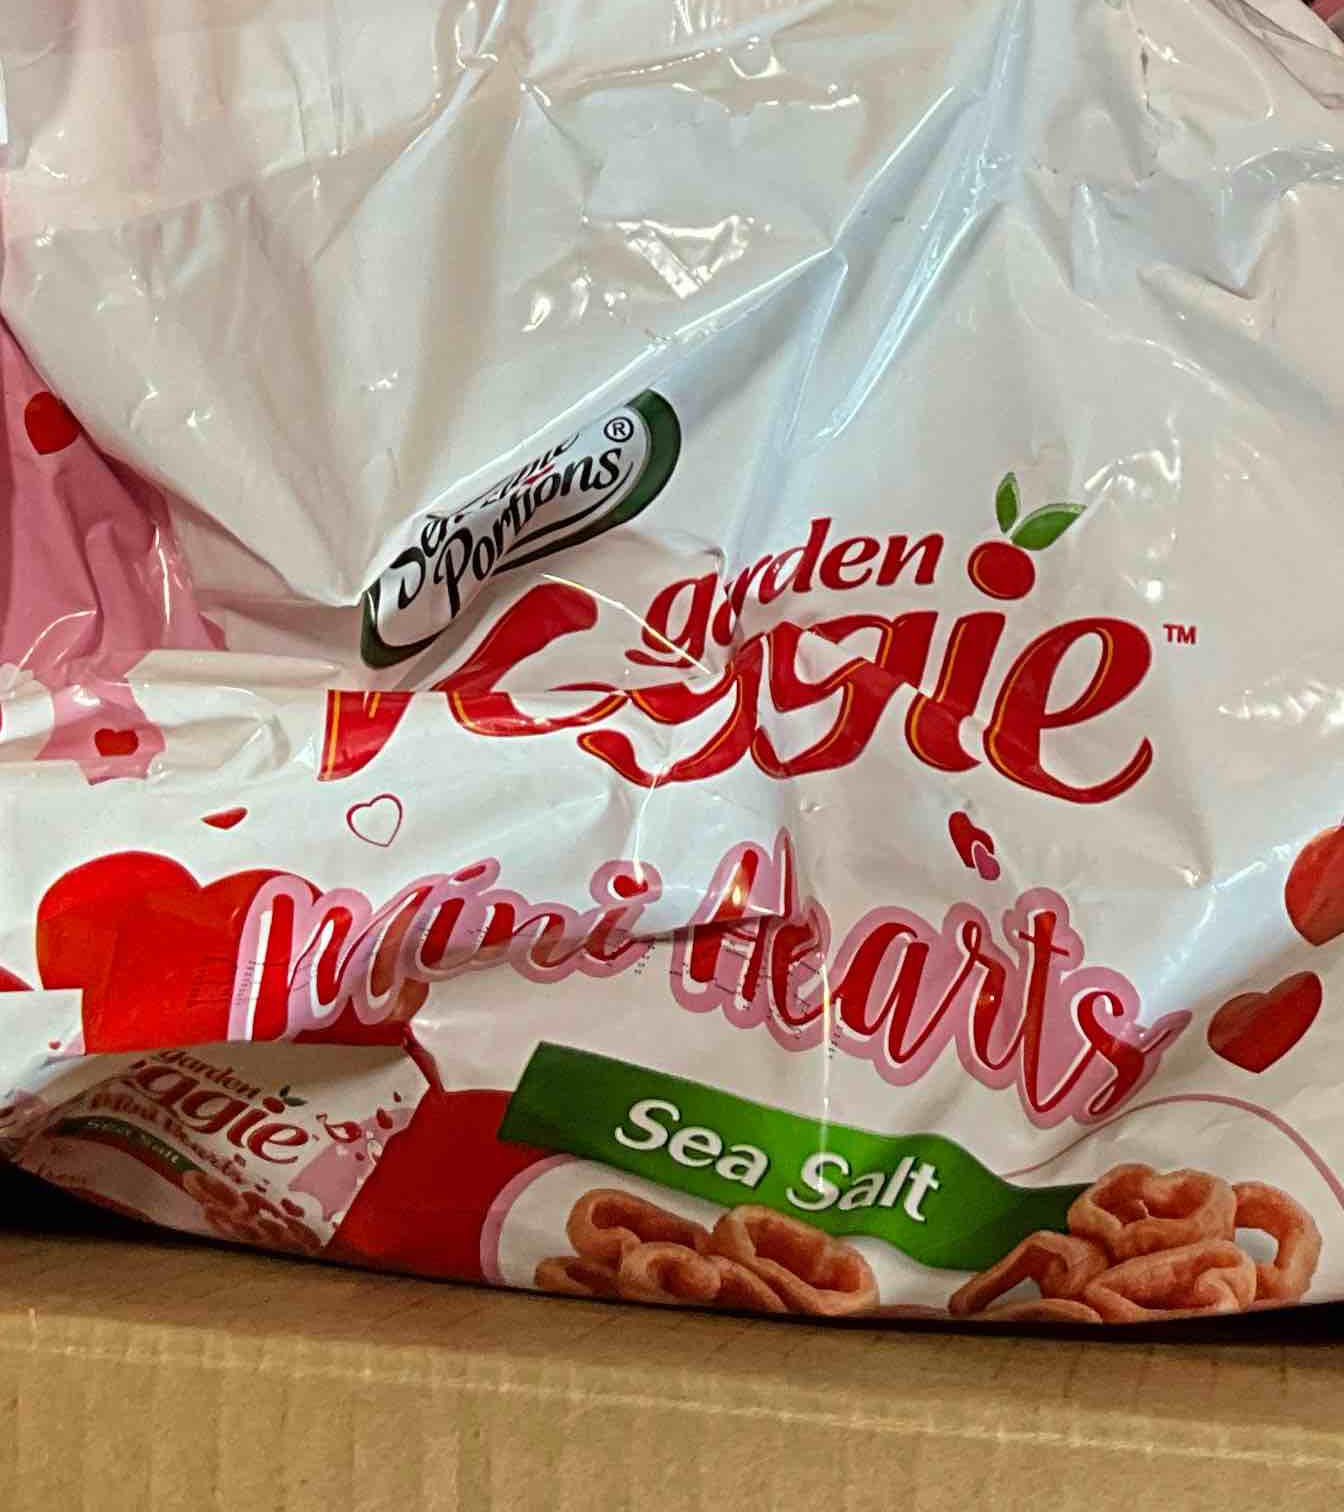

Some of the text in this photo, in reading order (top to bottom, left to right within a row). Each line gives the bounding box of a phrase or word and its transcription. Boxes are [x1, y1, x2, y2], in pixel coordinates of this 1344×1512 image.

[432, 447, 623, 620] Portions
[688, 832, 1182, 1113] Hearts
[613, 1097, 945, 1226] Sea Salt
